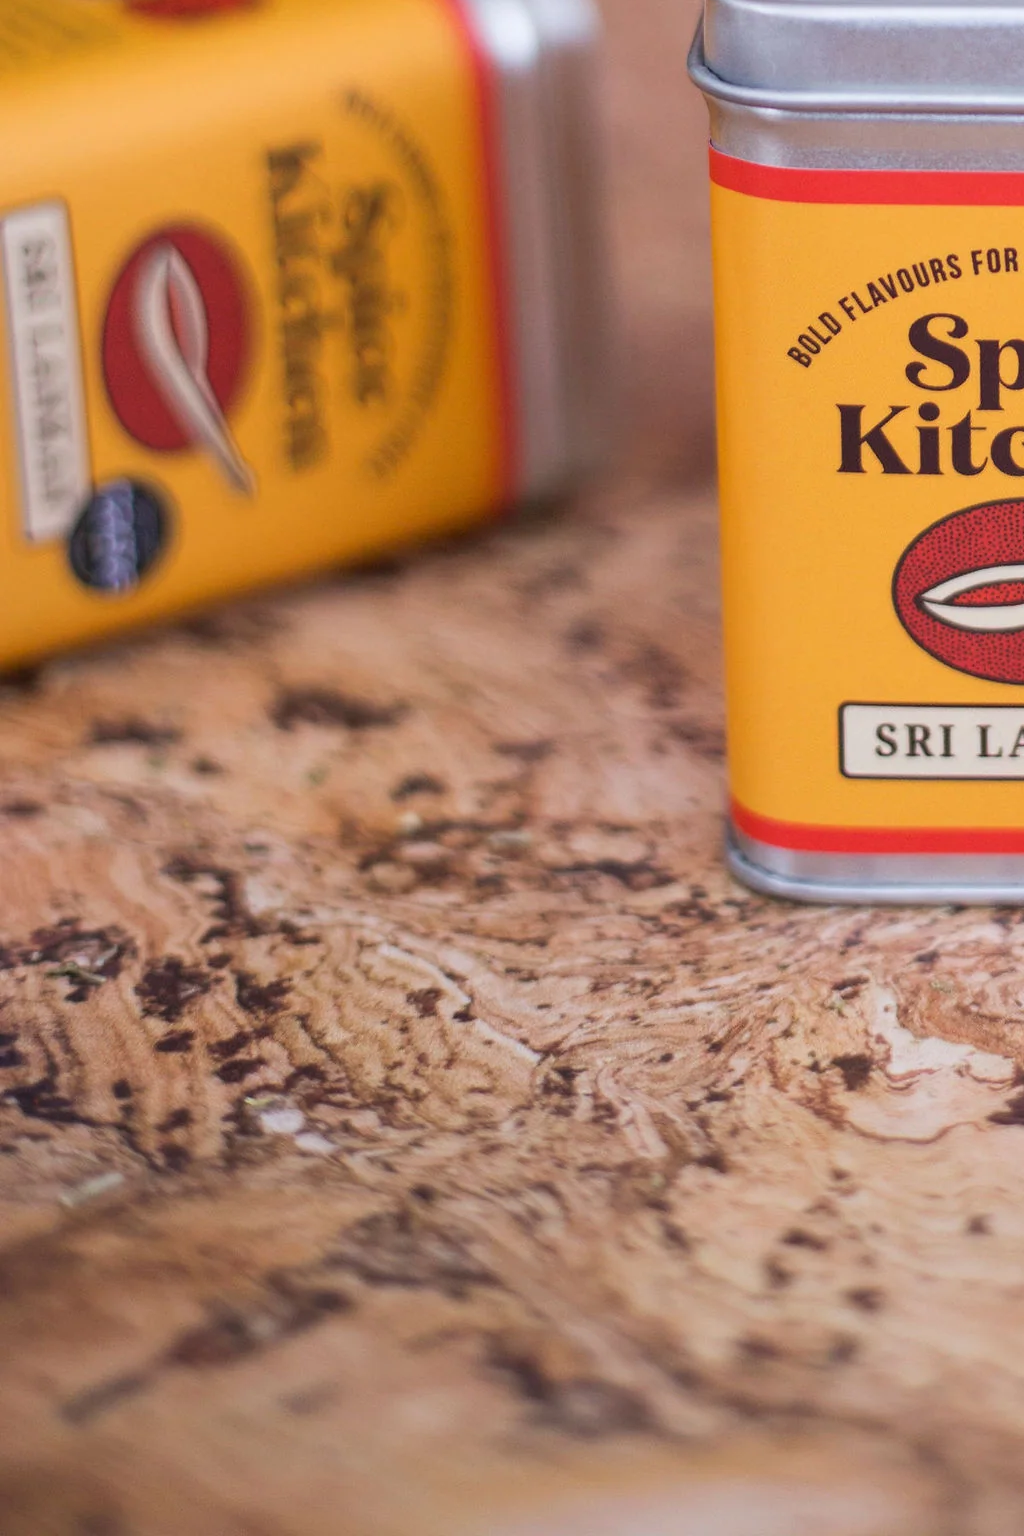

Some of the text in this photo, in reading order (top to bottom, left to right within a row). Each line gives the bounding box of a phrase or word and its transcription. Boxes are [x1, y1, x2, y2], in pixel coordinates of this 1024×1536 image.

[787, 312, 842, 368] BOLD
[838, 254, 962, 321] FLAVOURS
[971, 247, 1018, 275] FOR
[875, 723, 954, 758] SRI
